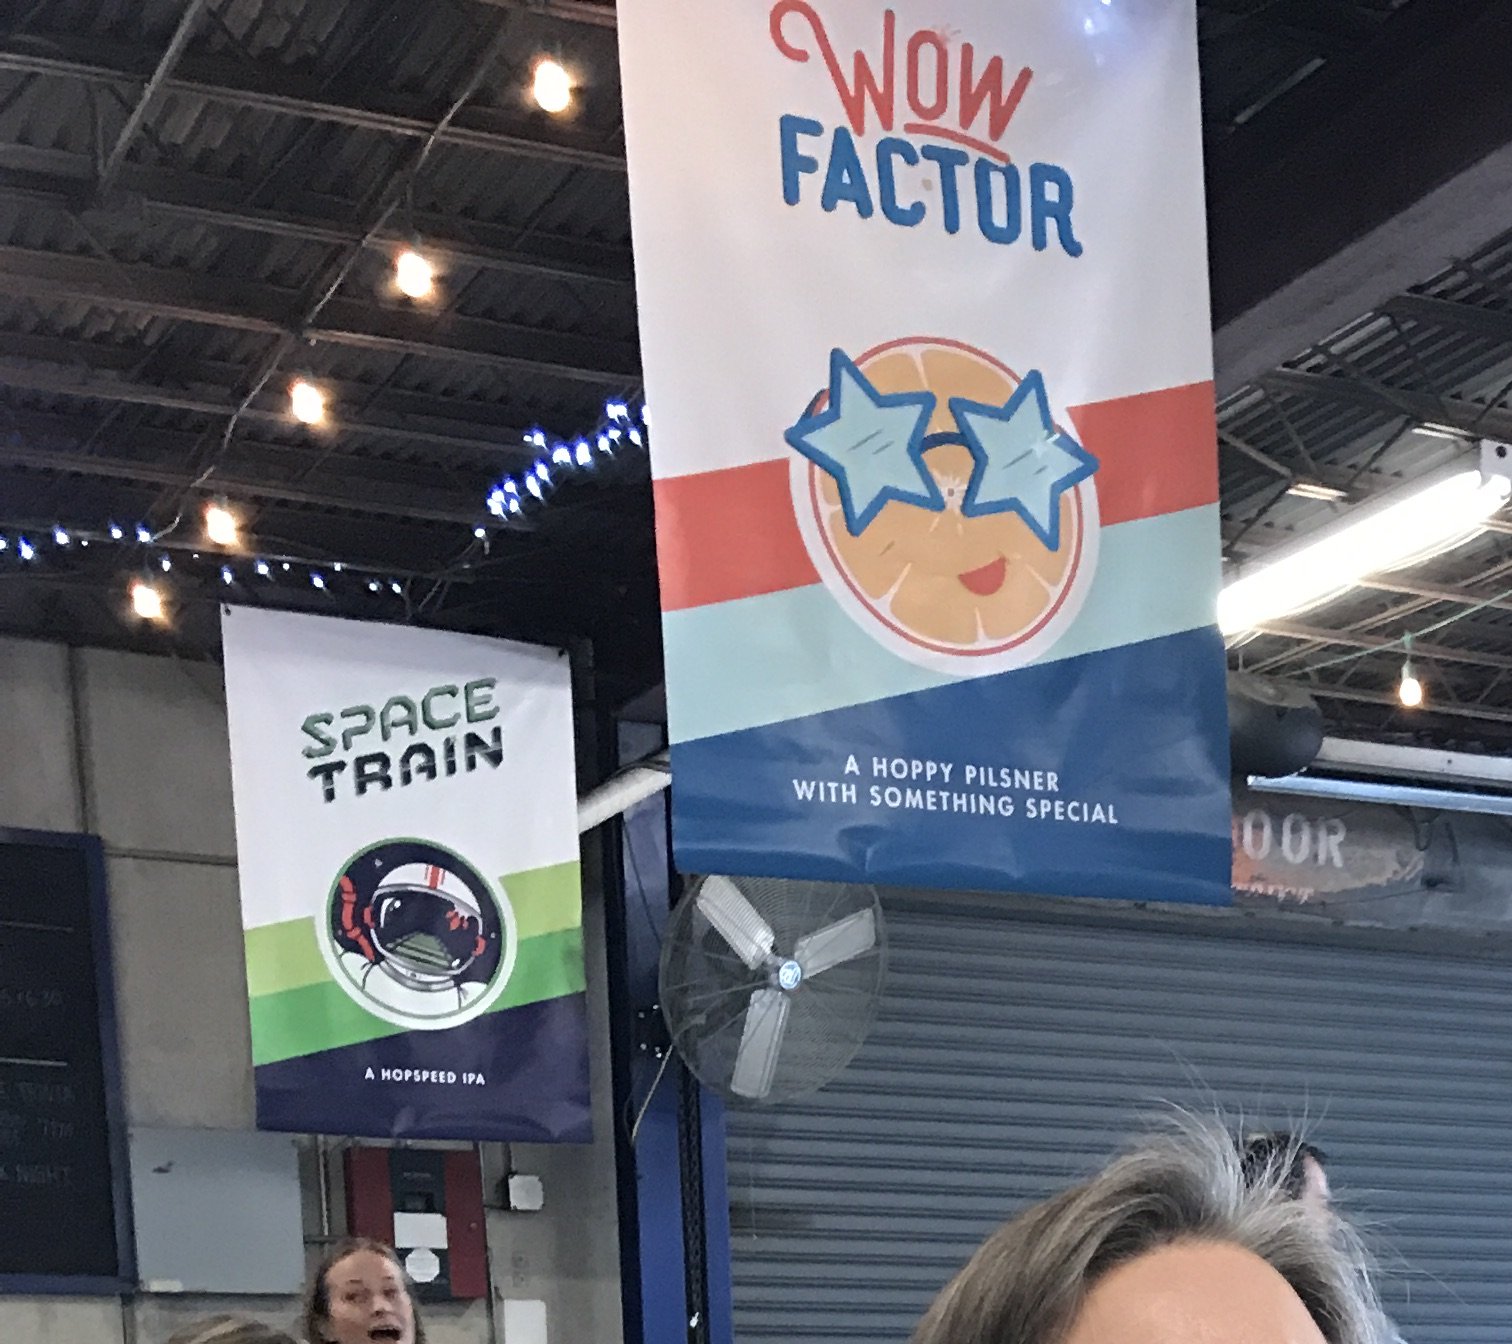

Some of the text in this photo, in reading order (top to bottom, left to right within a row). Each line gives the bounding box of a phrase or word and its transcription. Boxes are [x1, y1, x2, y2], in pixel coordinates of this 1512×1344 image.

[769, 0, 1033, 142] WOW
[780, 114, 1083, 258] FACTOR
[301, 677, 501, 759] SPACE
[306, 726, 504, 804] TRAIN
[845, 754, 1059, 792] A HOPPY PILSNER
[792, 779, 1118, 824] WITH SOMETHING SPECIAL
[1232, 808, 1346, 869] OOR
[364, 1066, 486, 1085] A HOPSPEED IPA
